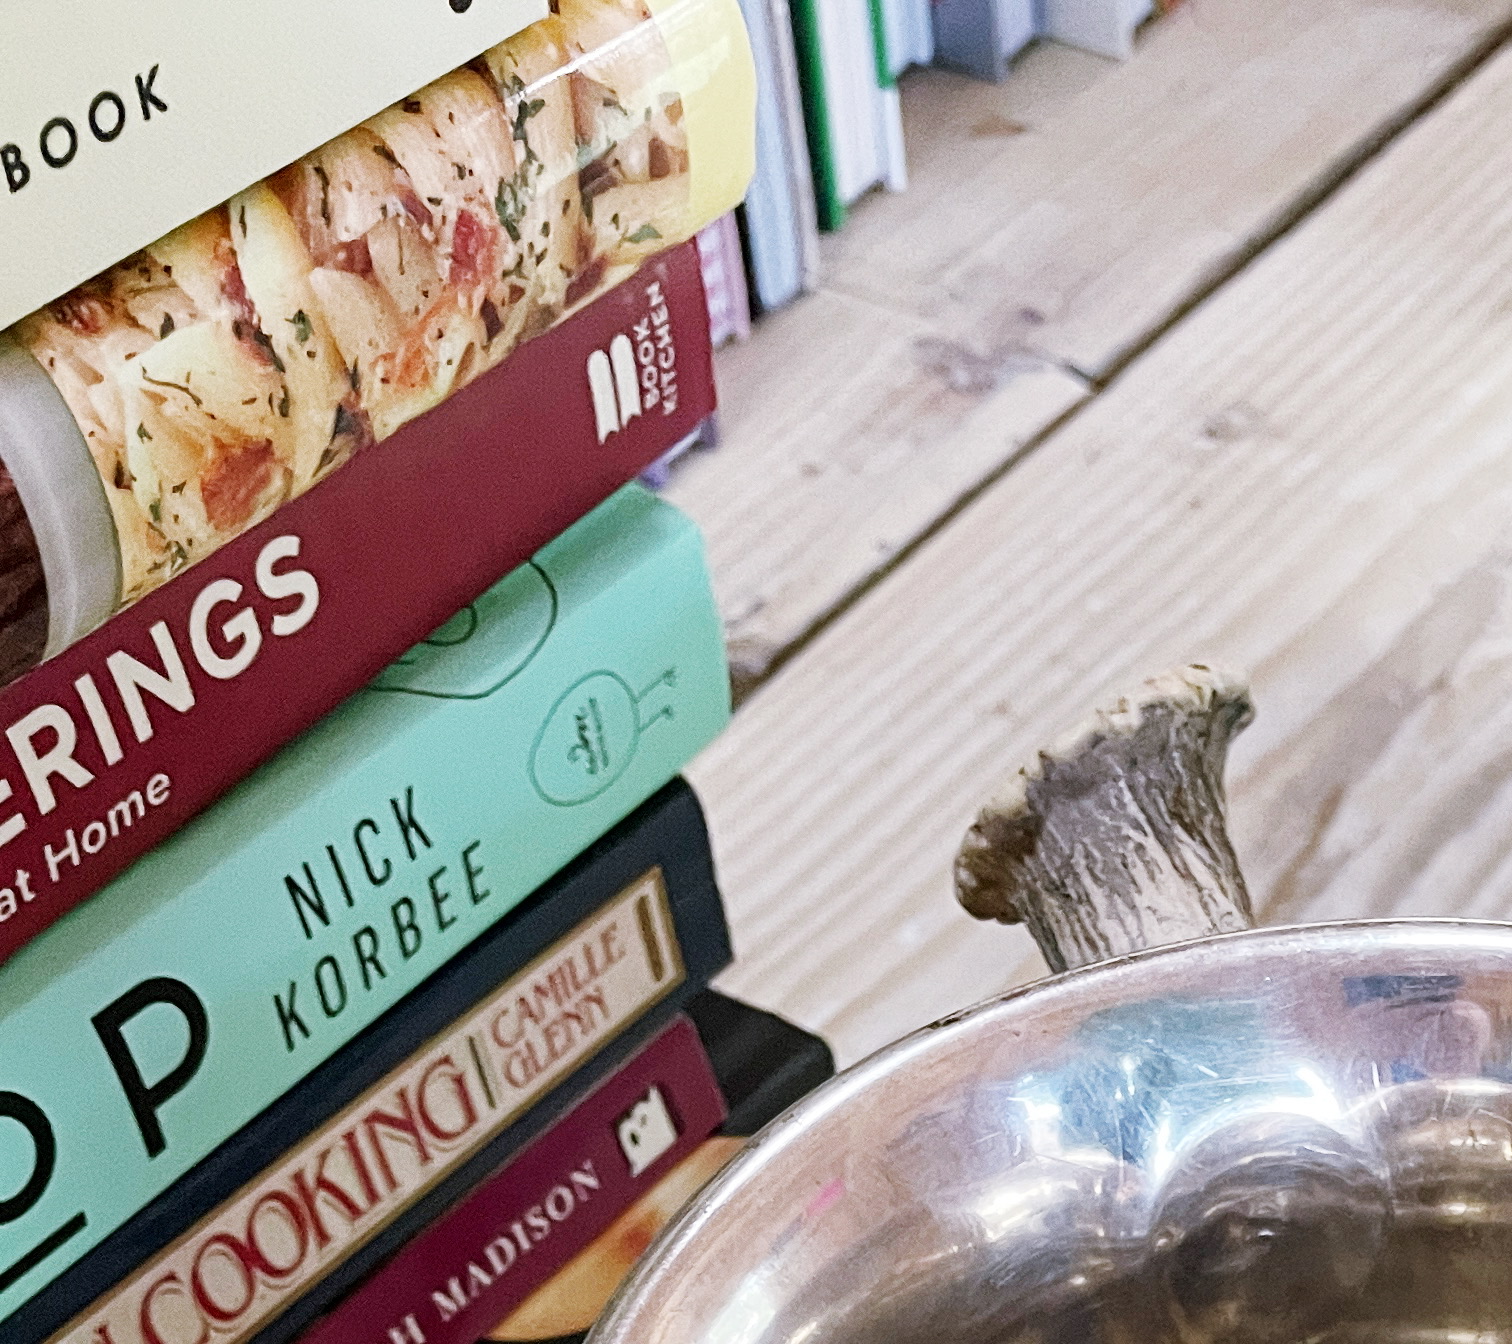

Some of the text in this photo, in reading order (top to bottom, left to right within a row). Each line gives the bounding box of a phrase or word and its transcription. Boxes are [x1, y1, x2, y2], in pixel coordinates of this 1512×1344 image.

[0, 63, 168, 193] BOOK
[633, 317, 661, 410] BOOK
[646, 281, 679, 416] KITCHEN
[0, 773, 171, 922] at Home
[284, 786, 432, 939] NICK
[274, 841, 490, 1052] KORBEE
[491, 921, 626, 1046] CAMILLE
[502, 988, 611, 1090] GLENN
[433, 1159, 602, 1319] MADISON
